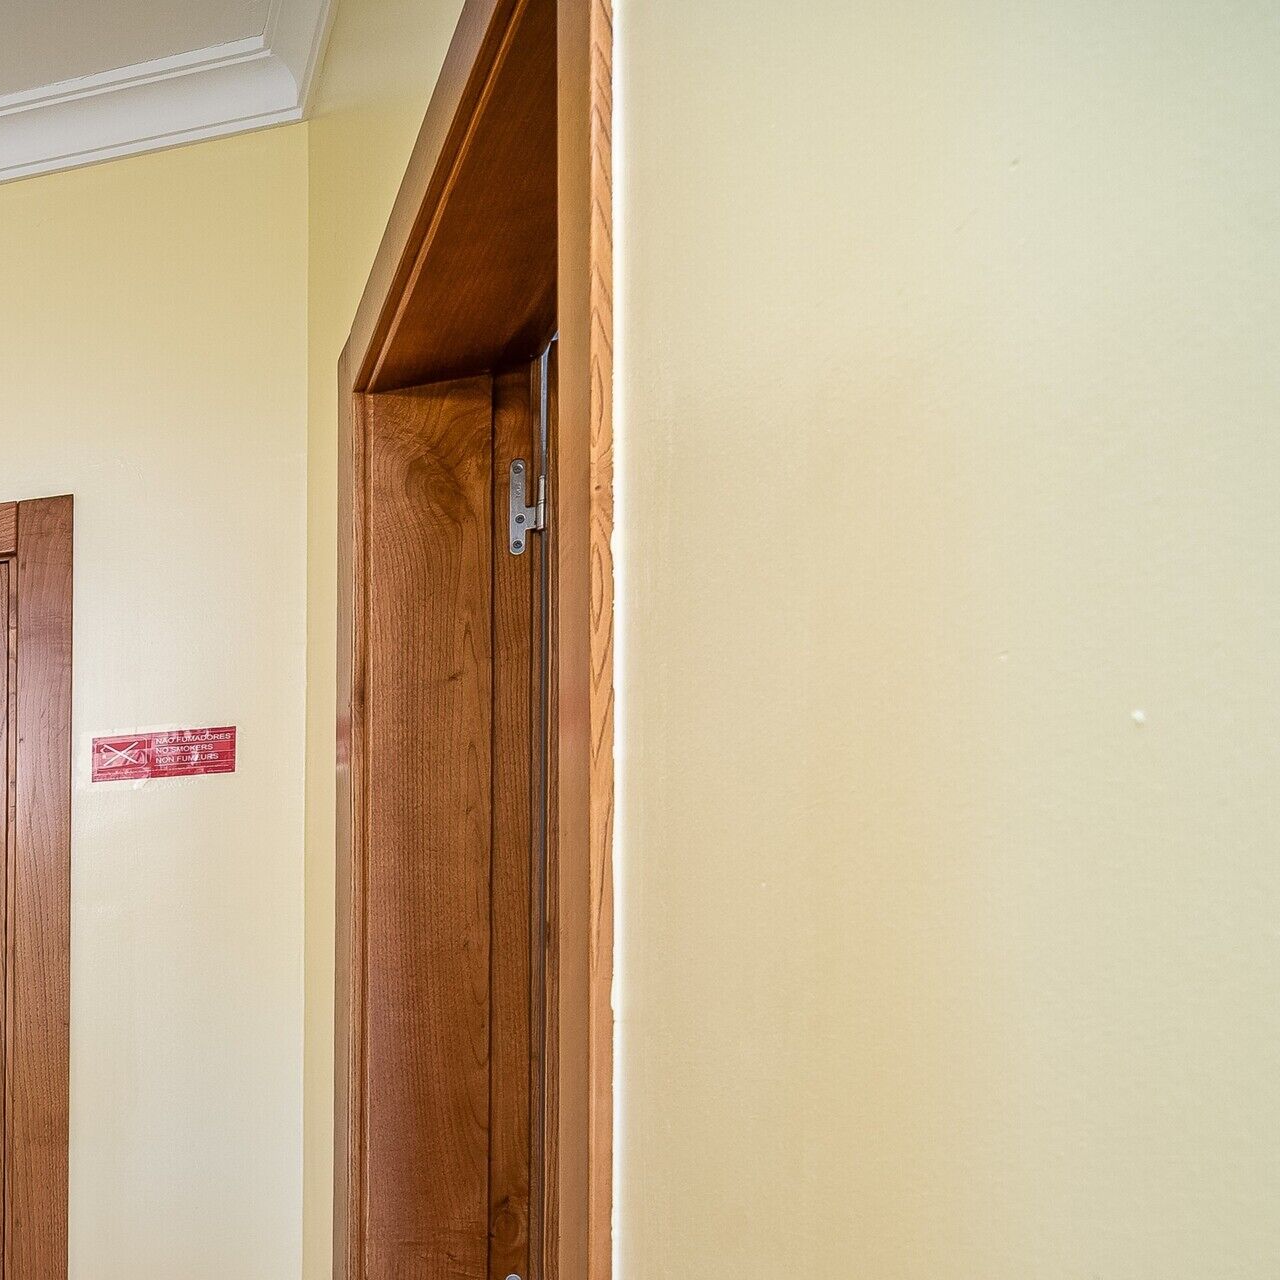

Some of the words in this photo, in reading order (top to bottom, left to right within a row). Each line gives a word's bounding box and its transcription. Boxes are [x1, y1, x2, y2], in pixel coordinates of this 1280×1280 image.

[176, 732, 231, 743] FUMADORES
[155, 746, 169, 754] NO
[171, 743, 214, 752] SMOKERS
[155, 756, 175, 764] NON
[176, 752, 219, 762] FUMURS
